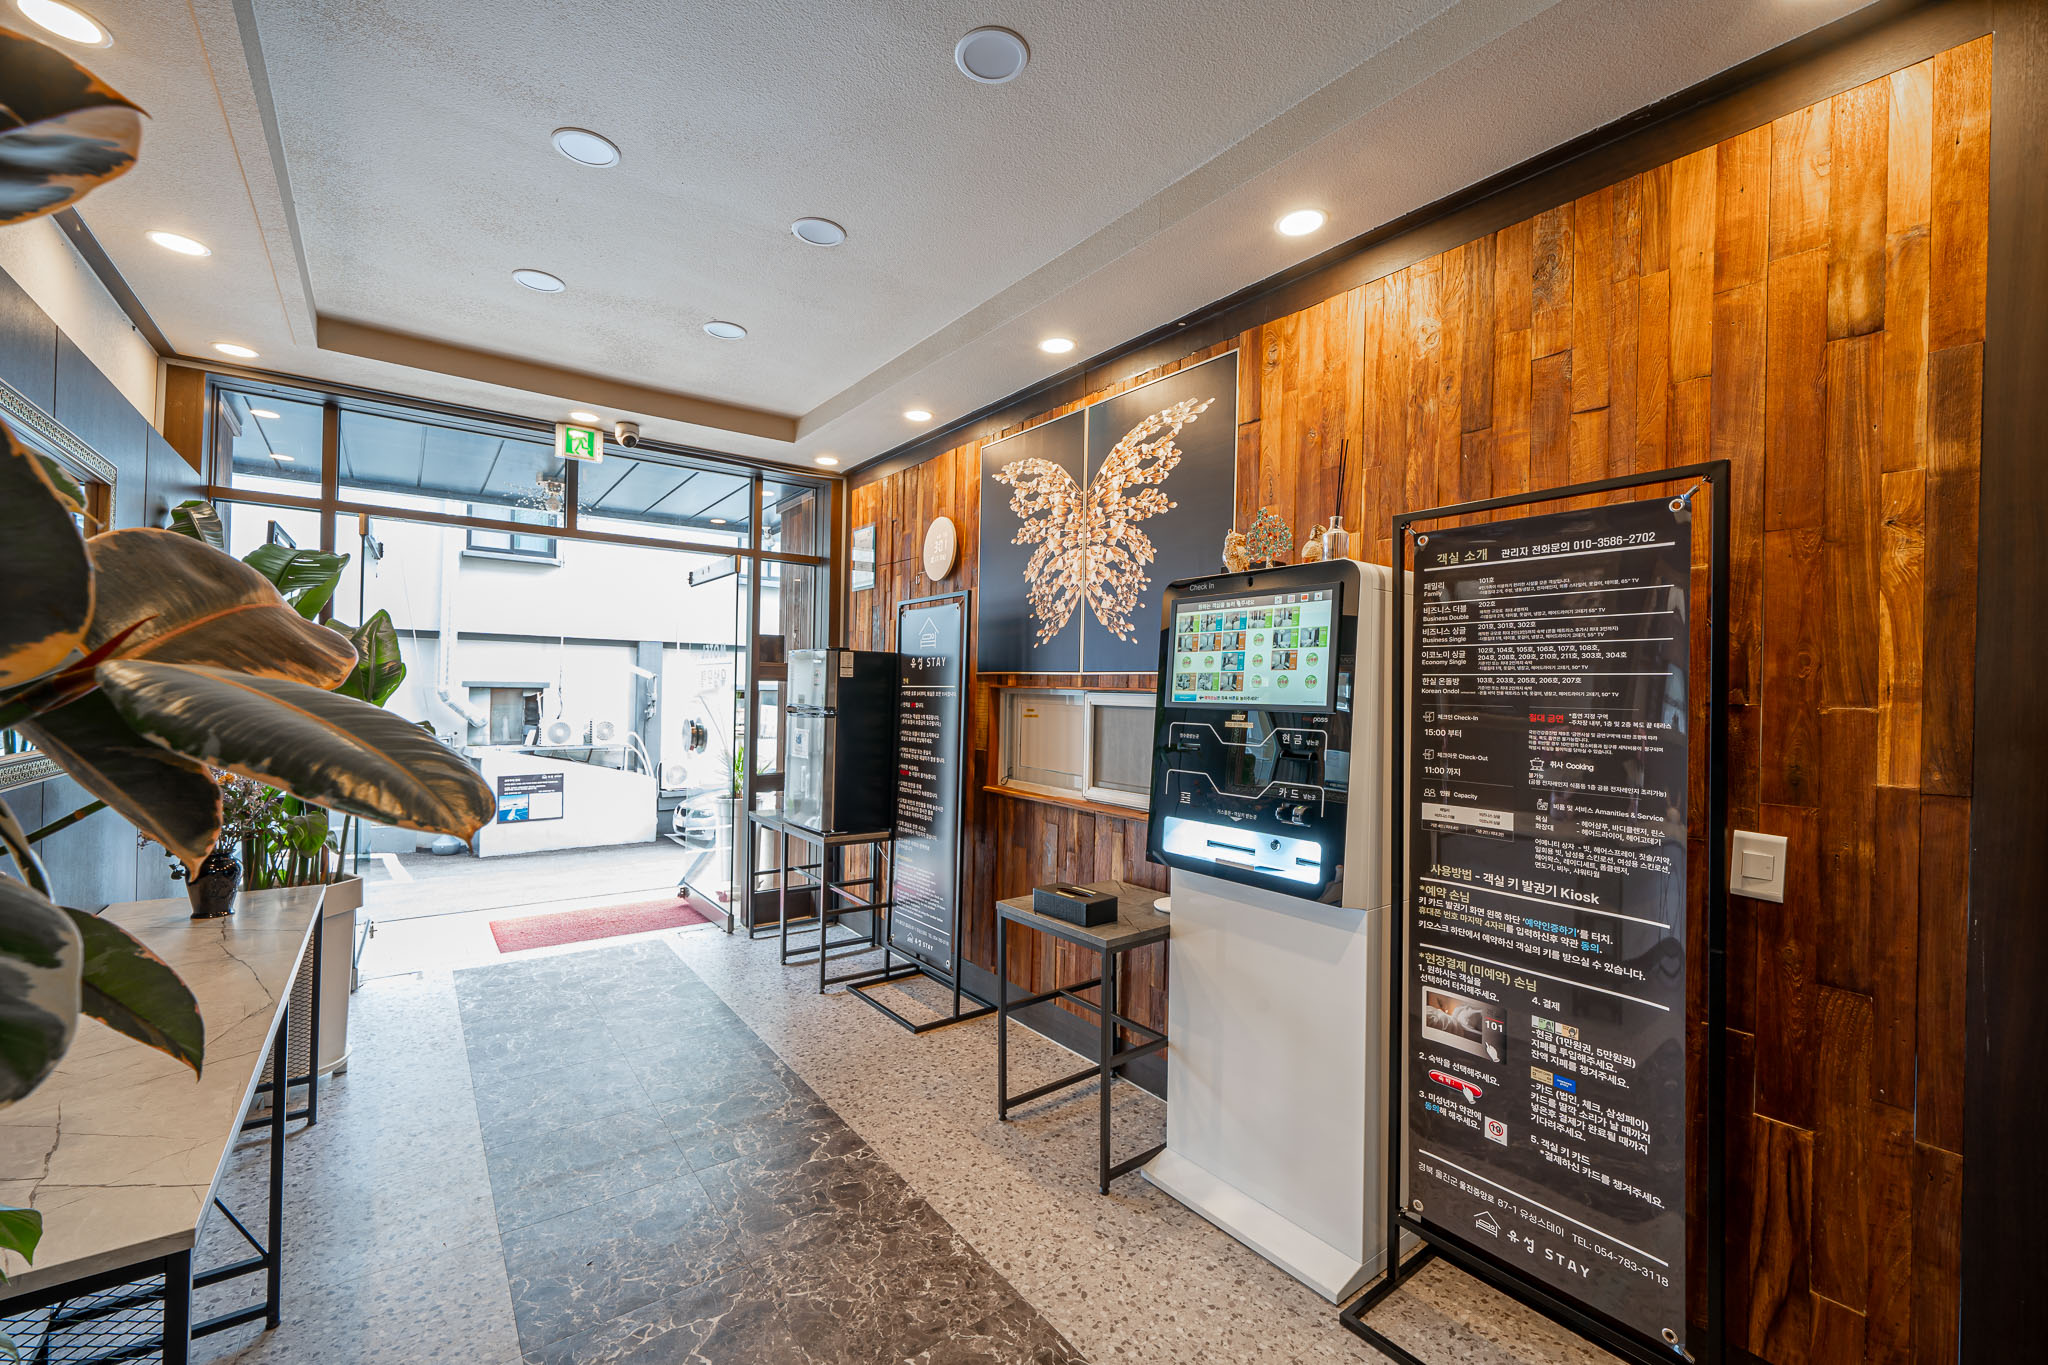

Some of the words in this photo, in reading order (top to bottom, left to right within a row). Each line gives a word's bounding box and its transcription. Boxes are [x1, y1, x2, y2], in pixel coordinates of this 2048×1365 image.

[1437, 552, 1459, 565] 객실
[1464, 548, 1488, 561] 소개
[1501, 547, 1528, 558] 관리자
[1532, 542, 1570, 554] 전화문의
[1573, 532, 1656, 549] 010-3586-2702
[1423, 606, 1451, 614] 비즈니스
[1452, 627, 1466, 635] 싱글
[926, 656, 946, 668] STAY
[1452, 650, 1466, 658] 싱글
[1529, 714, 1545, 722] 절대
[1548, 714, 1564, 723] 금연
[1446, 768, 1461, 776] 까지
[1566, 763, 1594, 772] Cooking
[1453, 792, 1478, 800] Capacity
[1595, 809, 1629, 817] Amanities
[1637, 813, 1664, 822] Service
[1430, 865, 1472, 880] 사용방법
[1482, 873, 1505, 887] 객실
[1507, 878, 1518, 890] 키
[1521, 880, 1557, 897] 발권기
[1560, 888, 1600, 904] Kiosk
[1449, 890, 1470, 903] 손님
[1418, 897, 1427, 907] 키
[1428, 898, 1444, 908] 카드
[1445, 901, 1468, 912] 발권기
[1470, 906, 1485, 917] 화면
[1487, 910, 1502, 920] 왼쪽
[1504, 914, 1520, 924] 하단
[1592, 933, 1613, 944] 터치.
[1418, 906, 1441, 917] 휴대폰
[1443, 911, 1459, 920] 번호
[1460, 914, 1482, 926] 마지막
[1484, 921, 1514, 934] 4자리를
[1516, 927, 1558, 943] 입력하신후
[1561, 937, 1578, 948] 약관
[1580, 941, 1602, 953] 동의.
[1418, 920, 1449, 932] 키오스크
[1450, 926, 1480, 940] 하단에서
[1482, 934, 1514, 948] 예약하신
[1516, 942, 1541, 955] 객실의
[1543, 949, 1560, 960] 키를
[1562, 953, 1590, 967] 받으실
[1592, 960, 1602, 969] 수
[1604, 963, 1646, 980] 있습니다.
[1420, 974, 1450, 988] 선택하여
[1452, 982, 1500, 1001] 터치해주세요.
[1427, 966, 1457, 979] 원하시는
[1459, 973, 1481, 986] 객실을
[1470, 965, 1511, 985] (미예약)
[1514, 977, 1537, 992] 손님
[1532, 997, 1541, 1005] 4.
[1543, 999, 1560, 1011] 결제
[1485, 1020, 1503, 1032] 101
[1531, 1039, 1557, 1054] 지폐를
[1559, 1048, 1618, 1072] 투입해주세요.
[1555, 1036, 1594, 1055] (1만원권,
[1596, 1049, 1636, 1068] 5만원권)
[1419, 1052, 1427, 1060] 2.
[1428, 1055, 1450, 1068] 숙박을
[1452, 1063, 1500, 1086] 선택해주세요.
[1531, 1049, 1548, 1062] 잔액
[1550, 1056, 1577, 1071] 지폐를
[1580, 1065, 1630, 1088] 챙겨주세요.
[1419, 1090, 1427, 1098] 3.
[1428, 1093, 1458, 1110] 미성년자
[1459, 1105, 1482, 1120] 약관에
[1424, 1102, 1447, 1116] 동의해
[1448, 1111, 1480, 1130] 해주세요.
[1530, 1092, 1557, 1108] 카드를
[1559, 1102, 1577, 1116] 딸깍
[1579, 1111, 1607, 1127] 소리가
[1621, 1126, 1651, 1144] 때까지
[1531, 1083, 1553, 1103] -카드
[1582, 1100, 1604, 1115] 체크,
[1606, 1109, 1649, 1131] 삼성페이)
[1490, 1125, 1501, 1134] 19
[1530, 1114, 1586, 1141] 기다려주세요.
[1530, 1103, 1557, 1118] 넣은후
[1559, 1113, 1585, 1130] 결제가
[1588, 1124, 1616, 1142] 완료될
[1619, 1136, 1648, 1154] 때까지
[1530, 1135, 1539, 1144] 5.
[1541, 1139, 1558, 1153] 객실
[1560, 1147, 1570, 1157] 키
[1571, 1152, 1591, 1165] 카드
[1582, 1167, 1610, 1185] 카드를
[1612, 1180, 1665, 1208] 챙겨주세요.
[1498, 1199, 1517, 1214] 87-1
[1520, 1209, 1564, 1236] 유성스테이
[1572, 1234, 1591, 1250] TEL:
[1594, 1245, 1669, 1286] 054-783-3118
[1545, 1249, 1590, 1277] STAY
